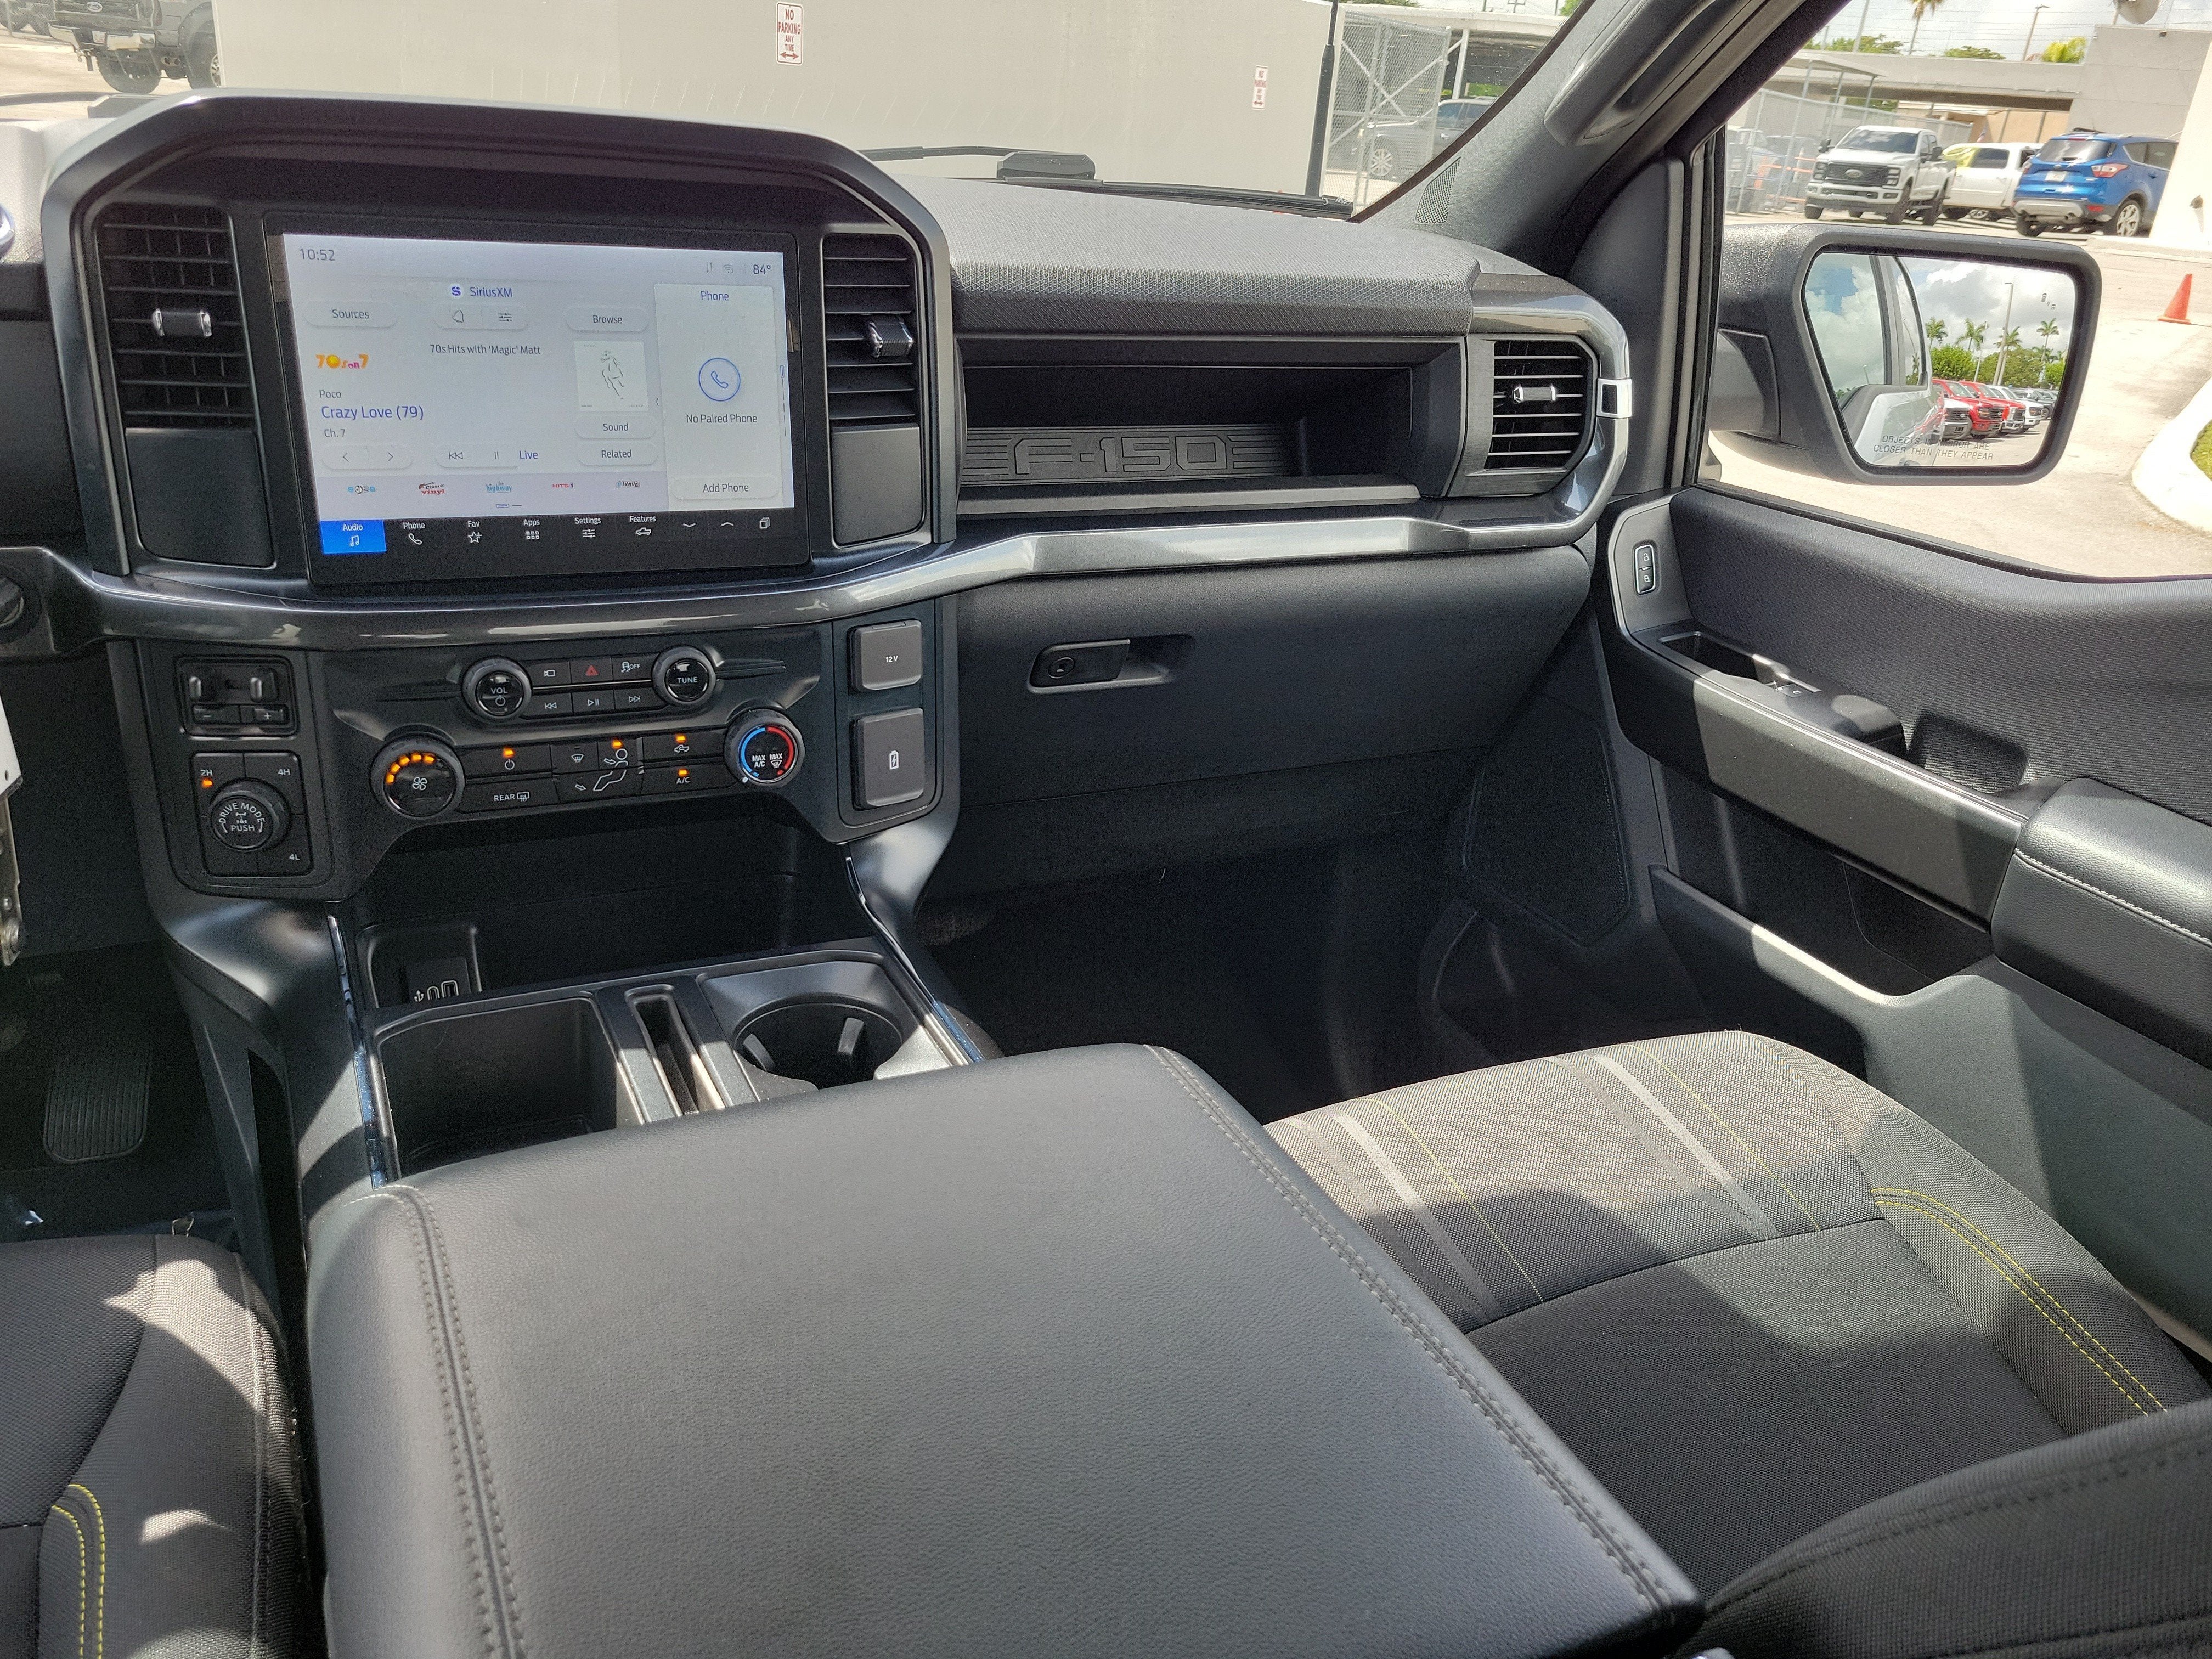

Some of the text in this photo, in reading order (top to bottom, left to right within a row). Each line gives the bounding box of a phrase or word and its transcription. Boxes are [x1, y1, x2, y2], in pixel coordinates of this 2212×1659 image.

[785, 9, 794, 20] NO
[778, 22, 801, 34] PARKING
[785, 35, 794, 43] ANY
[785, 43, 795, 52] TIME
[300, 249, 336, 261] 10:52
[470, 286, 513, 298] SiriusXM
[701, 291, 729, 301] Phone
[332, 308, 370, 319] Sources
[592, 314, 623, 324] Browse
[430, 345, 541, 356] 70s Hits with 'Magic' Matt
[319, 389, 342, 399] Poco
[321, 405, 424, 421] Crazy Love (79)
[686, 414, 758, 424] No Paired Phone
[603, 423, 629, 432] Sound
[1882, 435, 1920, 444] OBJECTS
[519, 450, 538, 460] Live
[601, 449, 632, 459] Related
[1014, 435, 1228, 476] F-150
[1874, 444, 1994, 460] CLOSER THAN THEY APPEAR
[703, 483, 749, 493] Add Phone
[467, 520, 480, 528] Fav
[523, 518, 540, 527] Apps
[574, 516, 601, 526] Settings
[629, 515, 656, 523] Features
[343, 523, 363, 532] Audio
[403, 522, 425, 530] Phone
[218, 803, 266, 824] DRIVE MODE
